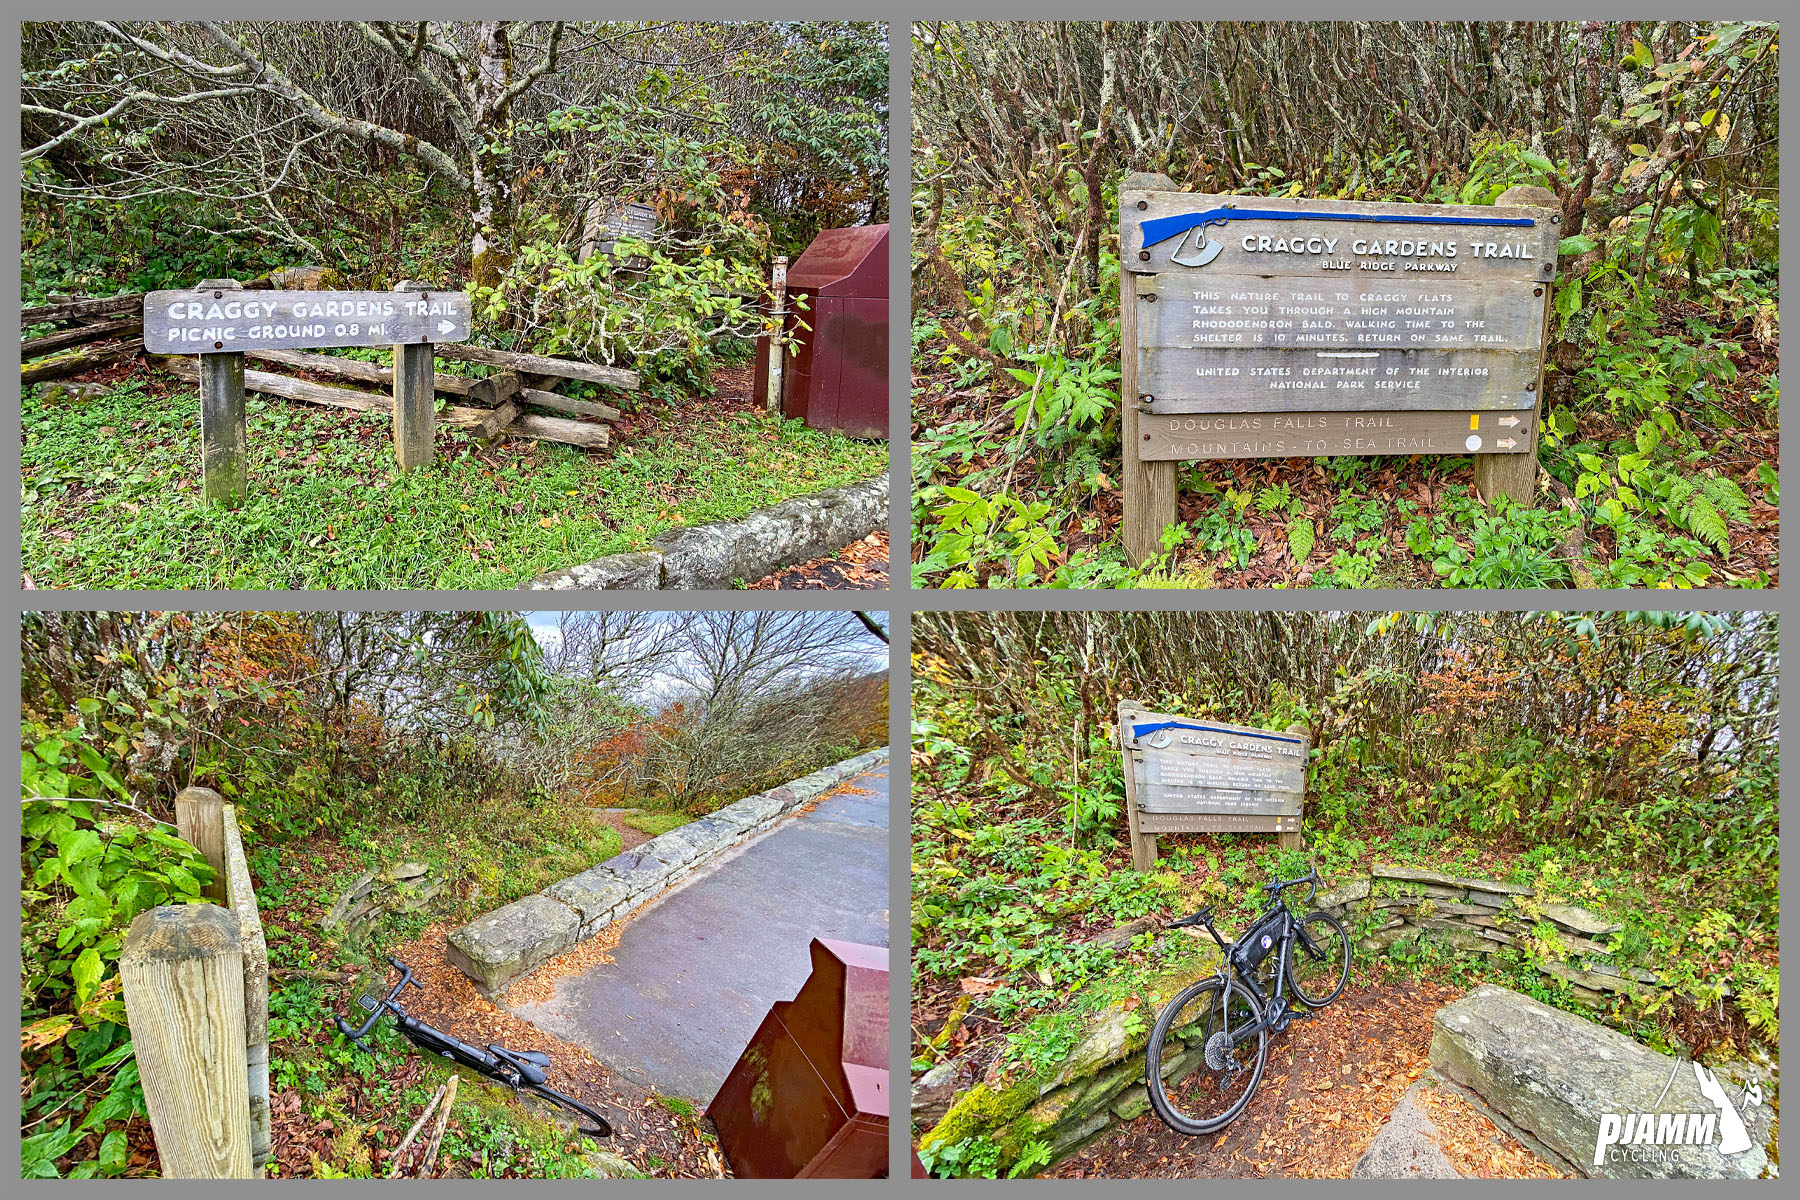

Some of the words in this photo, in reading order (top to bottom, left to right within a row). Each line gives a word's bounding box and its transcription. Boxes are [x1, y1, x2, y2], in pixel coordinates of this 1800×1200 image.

[1241, 235, 1338, 254] CRAGGY
[1352, 239, 1457, 258] GARDENS
[1470, 242, 1533, 259] TRAIL
[1322, 260, 1351, 271] BLUE
[1360, 261, 1395, 271] RIDGE
[1404, 262, 1458, 273] PARKWAY
[1193, 291, 1220, 300] THIS
[1231, 292, 1280, 301] NATURE
[1290, 292, 1324, 301] TRAIL
[1335, 292, 1349, 301] TO
[1360, 293, 1408, 301] CRAGGY
[1418, 294, 1453, 302] FLATS
[168, 301, 278, 320] CRAGGY
[293, 300, 394, 317] GARDENS
[405, 301, 457, 317] TRAIL
[1193, 305, 1232, 314] TAKES
[1243, 306, 1268, 315] YOU
[1279, 306, 1333, 315] THROUGH
[1343, 307, 1351, 315] A
[1361, 307, 1387, 315] HIGH
[1396, 307, 1455, 315] MOUNTAIN
[1192, 320, 1292, 328] RHODODENDRON
[1302, 320, 1336, 328] BALD.
[1346, 320, 1396, 328] WALKING
[1405, 320, 1431, 328] TIME
[1441, 320, 1455, 328] TO
[1465, 320, 1485, 328] THE
[168, 325, 236, 342] PICNIC
[249, 323, 325, 339] GROUND
[368, 323, 389, 336] MI.
[1193, 333, 1243, 342] SHELTER
[1253, 333, 1263, 342] IS
[1274, 333, 1286, 342] 10
[1296, 333, 1348, 342] MINUTES.
[1358, 334, 1401, 342] RETURN
[1410, 334, 1425, 342] ON
[1435, 334, 1464, 342] SAME
[1474, 334, 1508, 342] TRAIL.
[1196, 367, 1240, 376] UNITED
[1250, 367, 1291, 376] STATES
[1303, 367, 1376, 376] DEPARTMENT
[1385, 367, 1399, 376] OF
[1409, 367, 1430, 376] THE
[1438, 367, 1489, 376] INTERIOR
[1270, 381, 1327, 389] NATIONAL
[1336, 381, 1365, 389] PARK
[1374, 380, 1421, 389] SERVICE
[1170, 417, 1262, 431] DOUGLAS
[1273, 417, 1328, 429] FALLS
[1344, 416, 1394, 428] TRAIL
[1386, 437, 1436, 448] TRAIL
[1180, 735, 1224, 747] CRAGGY
[1230, 741, 1273, 753] GARDENS
[1277, 747, 1301, 757] TRAIL
